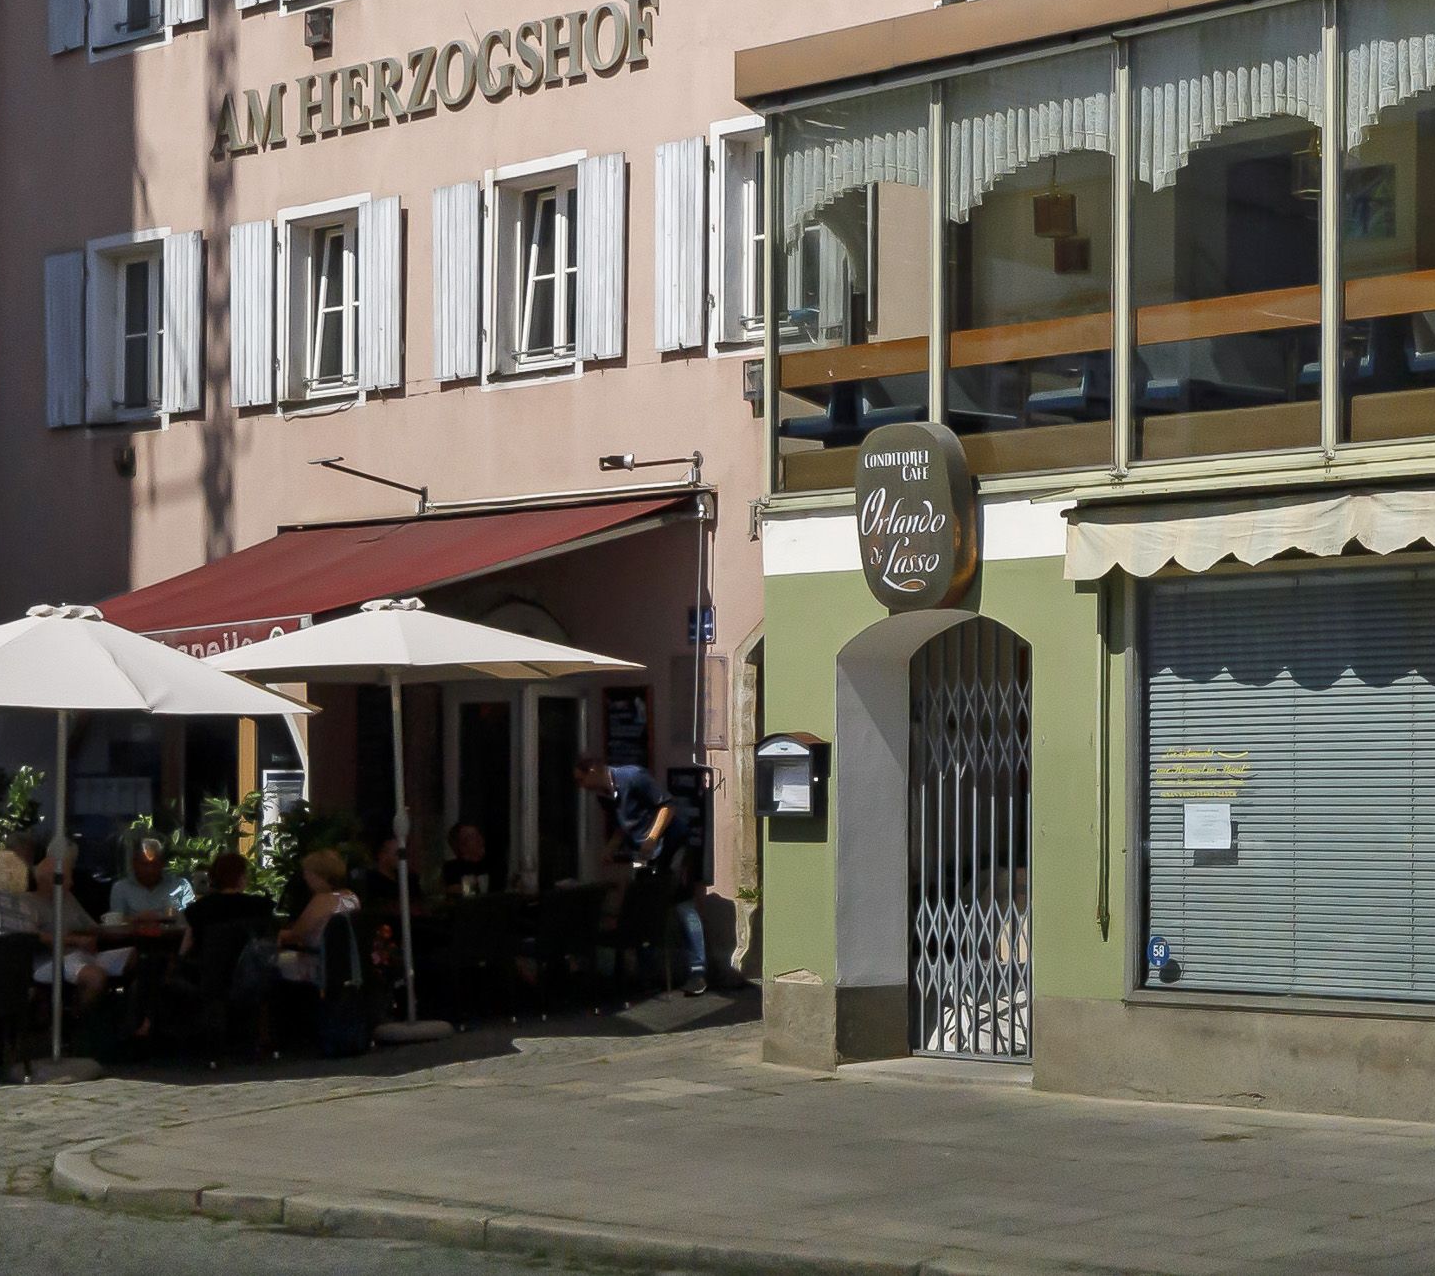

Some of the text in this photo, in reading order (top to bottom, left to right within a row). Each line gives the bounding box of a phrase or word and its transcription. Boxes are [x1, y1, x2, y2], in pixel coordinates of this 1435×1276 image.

[213, 81, 287, 155] AM
[861, 487, 946, 536] Orlando
[870, 536, 940, 592] di Lasso
[1153, 944, 1165, 958] 58
